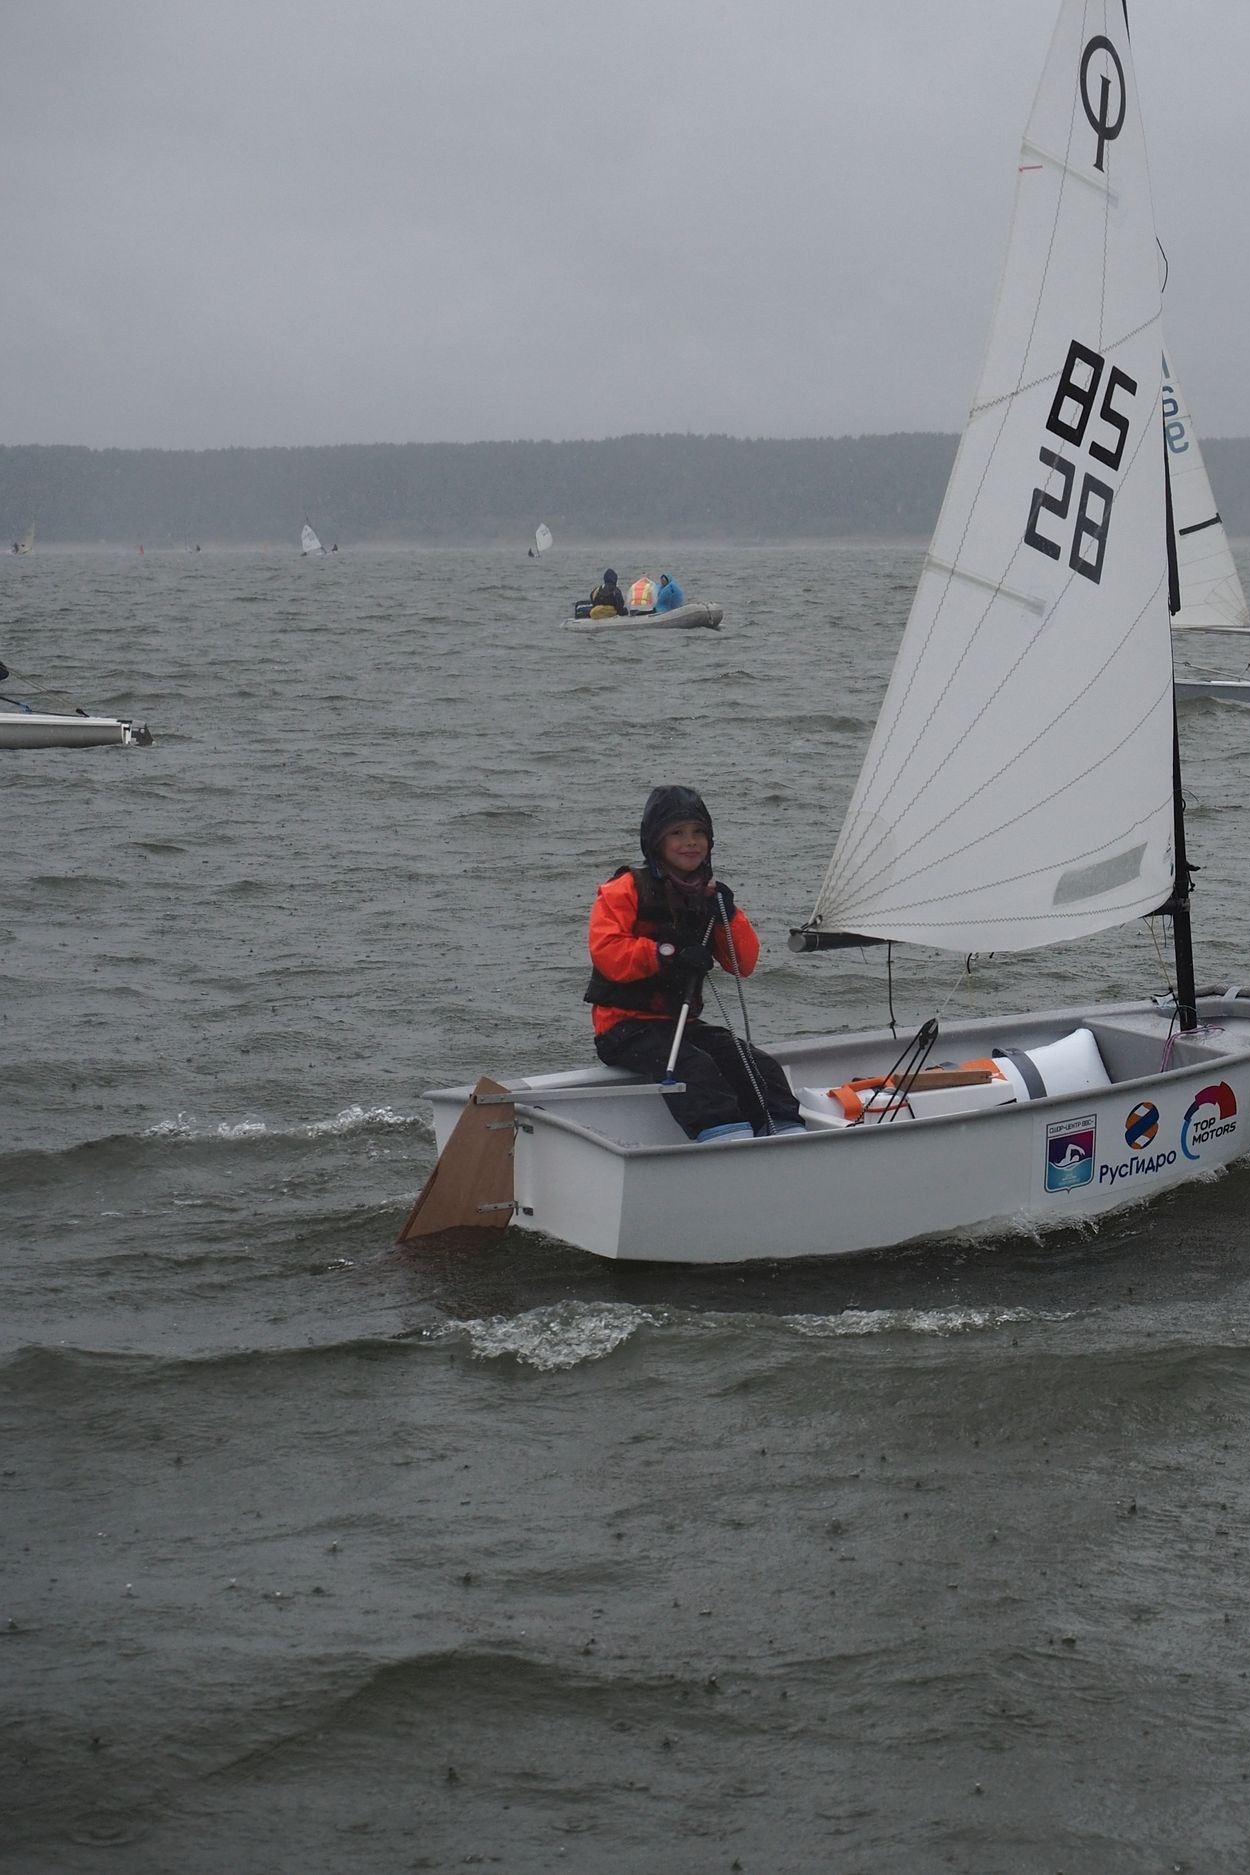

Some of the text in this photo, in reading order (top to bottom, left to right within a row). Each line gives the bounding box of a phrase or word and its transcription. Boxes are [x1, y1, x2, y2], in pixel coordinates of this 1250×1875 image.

[1046, 339, 1138, 472] 85
[1024, 446, 1114, 584] 28
[1192, 1121, 1237, 1146] MOTORS
[1193, 1117, 1216, 1133] TOP
[1099, 1150, 1177, 1185] РусГидро
